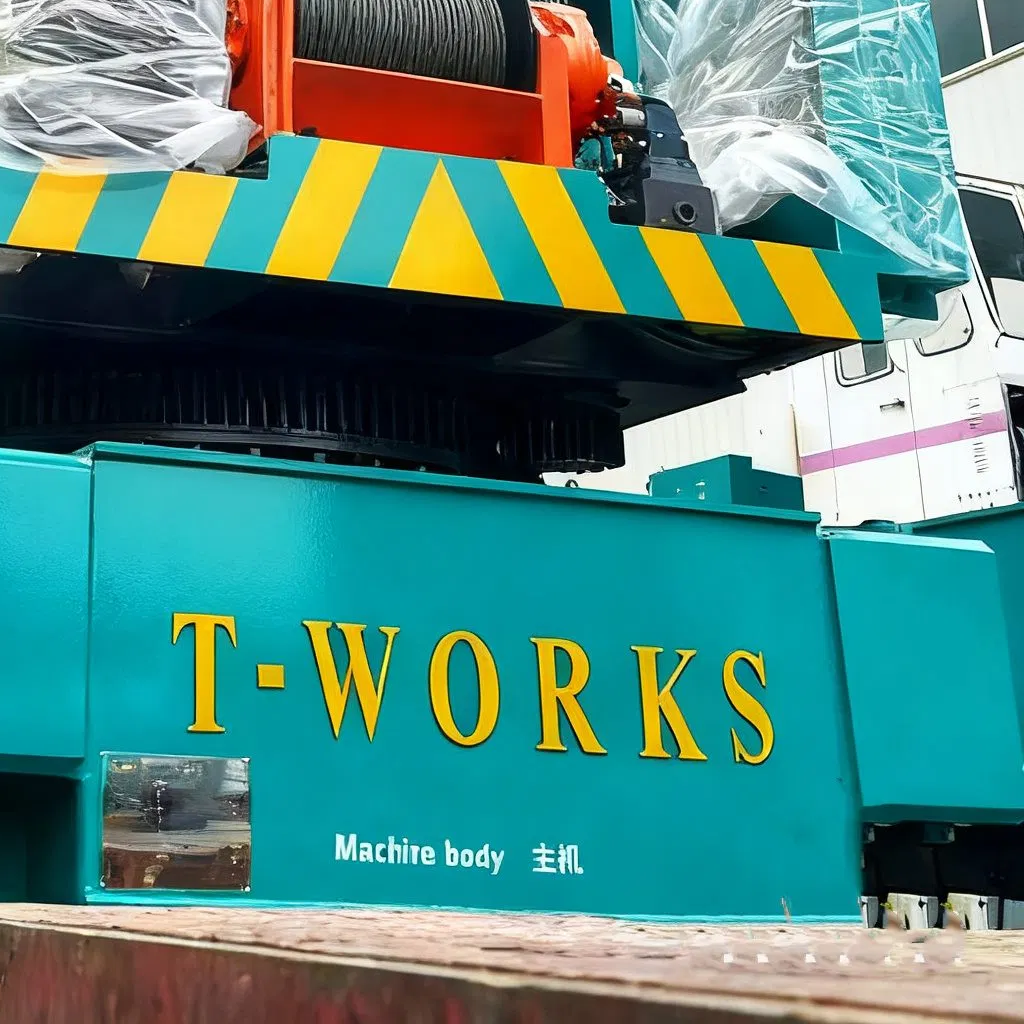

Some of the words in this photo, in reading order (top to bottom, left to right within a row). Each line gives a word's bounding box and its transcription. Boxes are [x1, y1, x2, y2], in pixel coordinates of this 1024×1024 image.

[172, 612, 775, 765] T-WORKS
[444, 838, 505, 876] body
[531, 842, 585, 875] 主机
